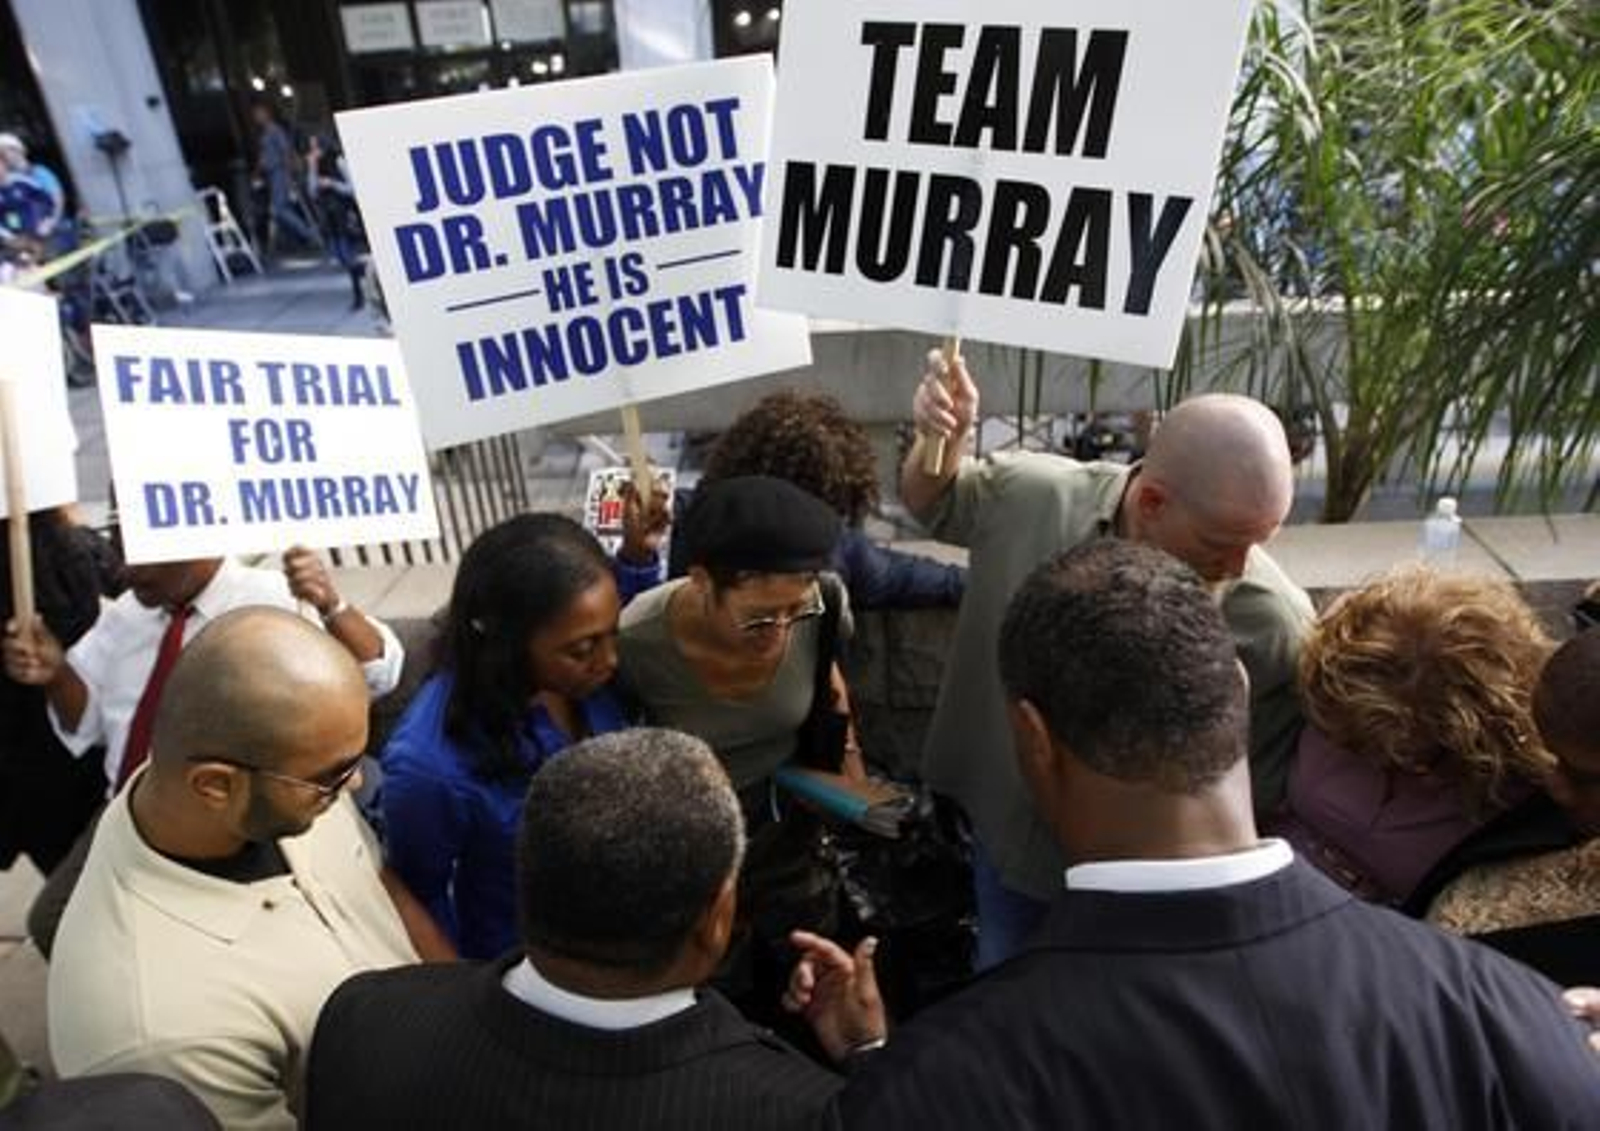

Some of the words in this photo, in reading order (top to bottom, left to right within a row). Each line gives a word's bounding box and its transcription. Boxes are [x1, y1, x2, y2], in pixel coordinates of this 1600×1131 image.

[861, 21, 1129, 159] TEAM
[408, 118, 613, 214] JUDGE
[623, 98, 740, 175] NOT
[394, 213, 508, 285] DR.
[516, 163, 766, 260] MURRAY
[542, 259, 597, 313] HE
[608, 251, 648, 299] IS
[776, 161, 1193, 317] MURRAY
[114, 355, 245, 405] FAIR
[258, 361, 400, 407] TRIAL
[456, 284, 748, 403] INNOCENT
[229, 418, 316, 464] FOR
[144, 482, 227, 528] DR.
[239, 474, 420, 523] MURRAY
